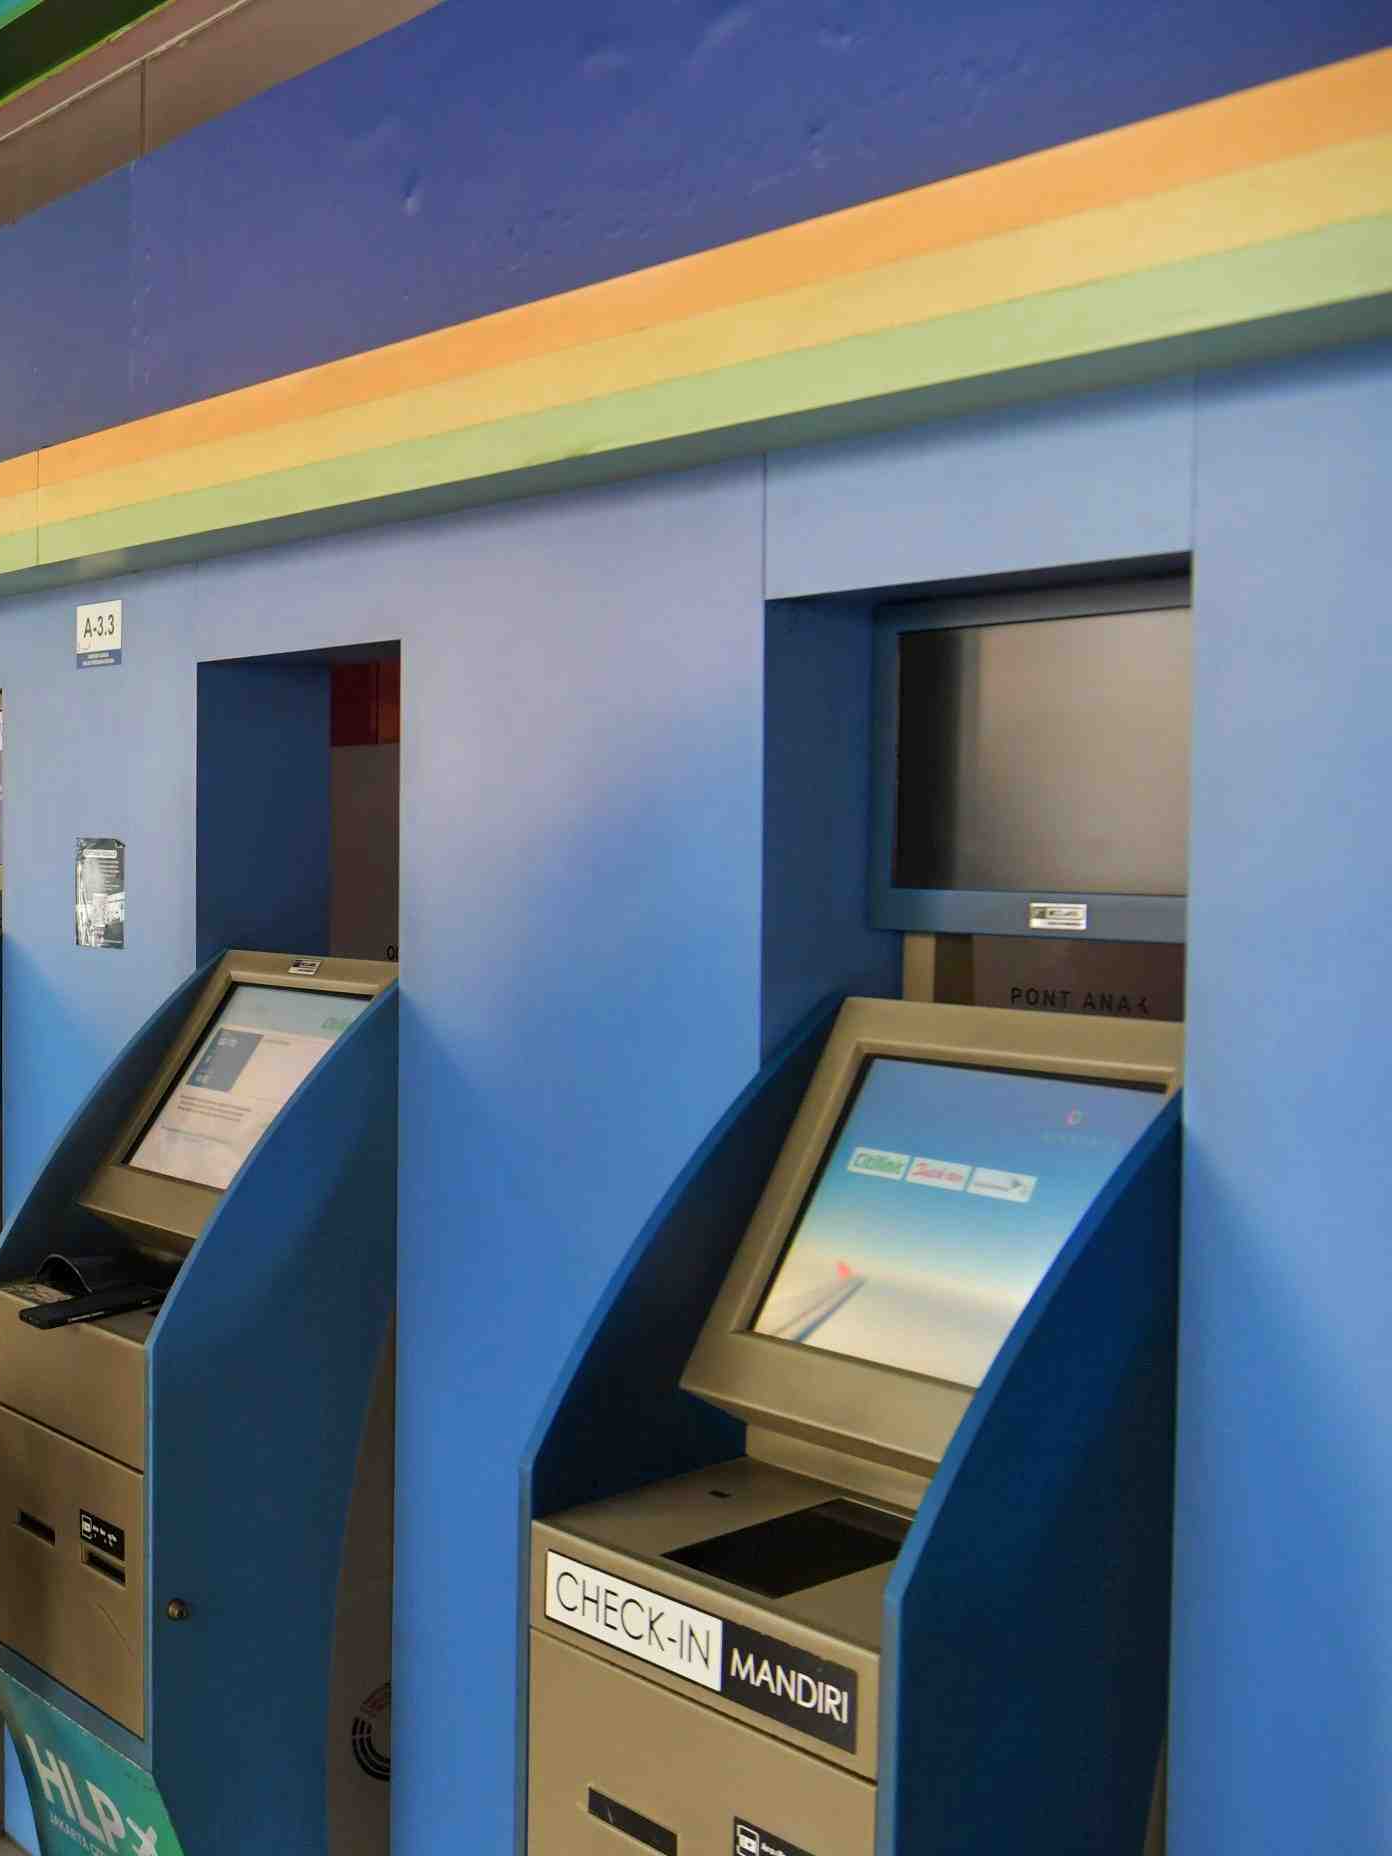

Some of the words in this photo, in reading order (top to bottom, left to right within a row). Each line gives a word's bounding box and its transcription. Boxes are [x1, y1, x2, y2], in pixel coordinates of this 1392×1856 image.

[83, 614, 115, 638] A-3.3
[556, 1572, 710, 1670] CHECK-IN
[730, 1647, 849, 1724] MANDIRI
[25, 1733, 126, 1854] HLP
